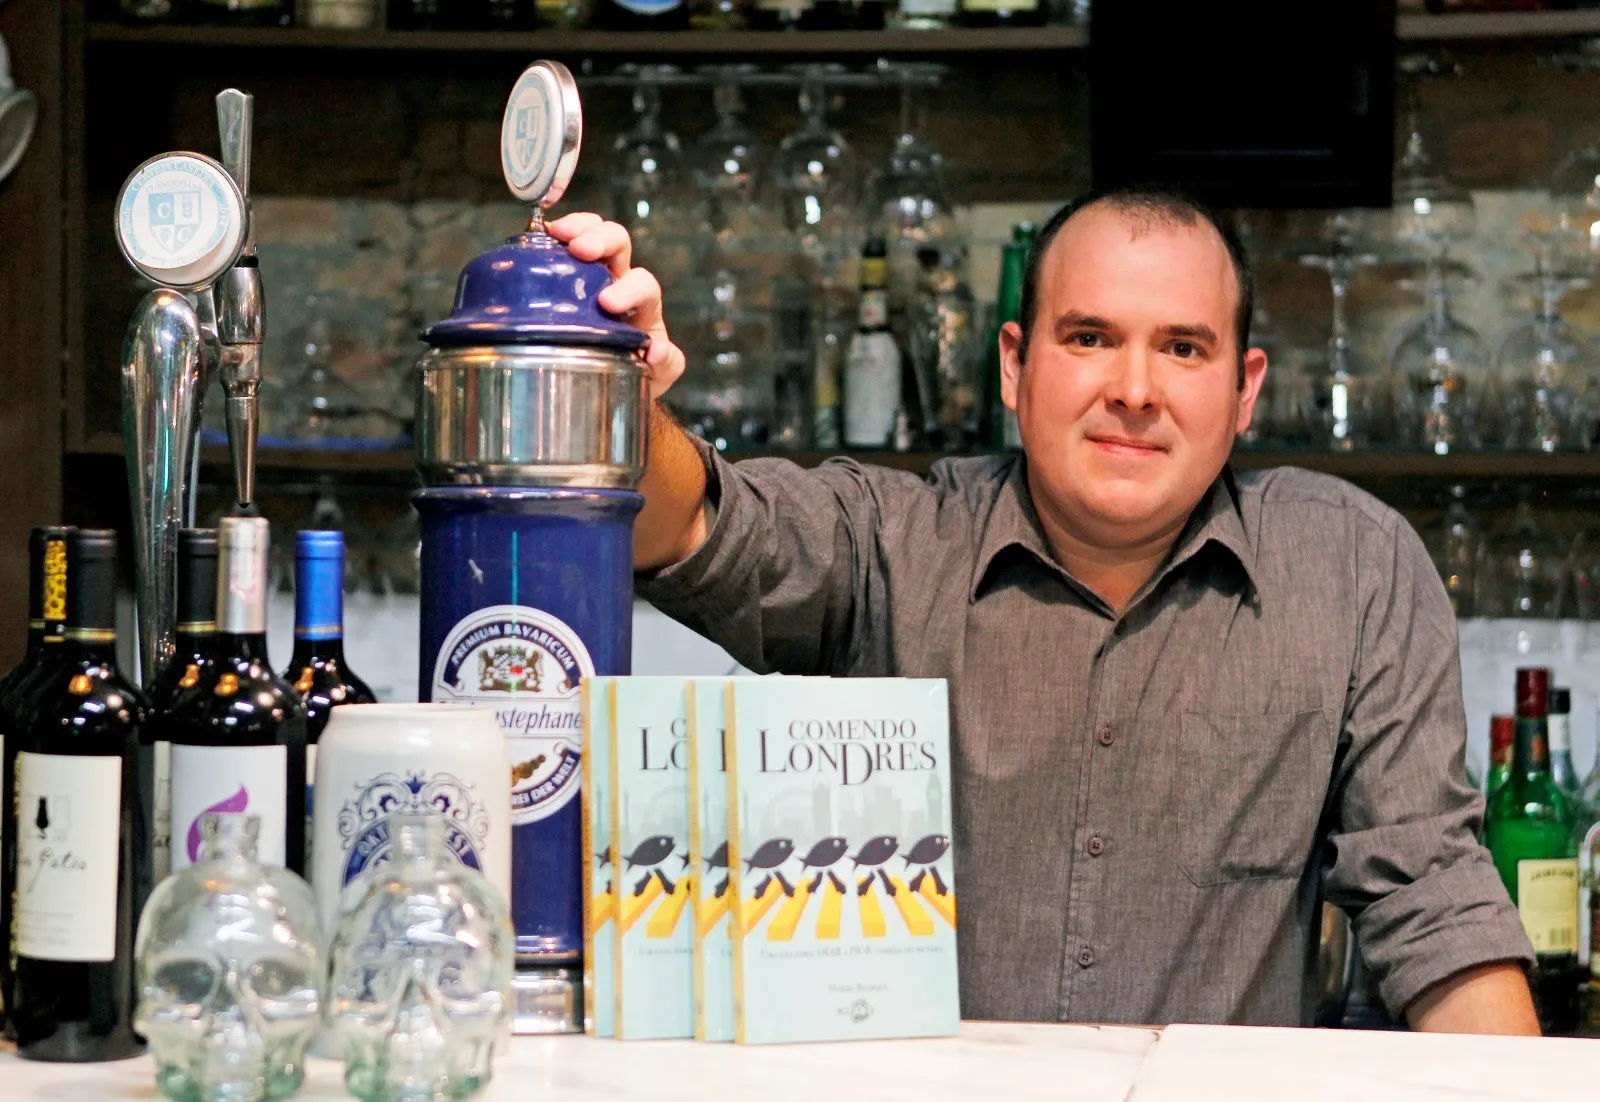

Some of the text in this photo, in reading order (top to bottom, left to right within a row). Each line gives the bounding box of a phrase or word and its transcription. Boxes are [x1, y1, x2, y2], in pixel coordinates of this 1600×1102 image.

[157, 202, 171, 219] C
[451, 623, 576, 670] PREMIUM BAVARICUM
[788, 718, 917, 740] COMENDO
[530, 755, 576, 802] DER WELT
[757, 727, 937, 786] LONDRES
